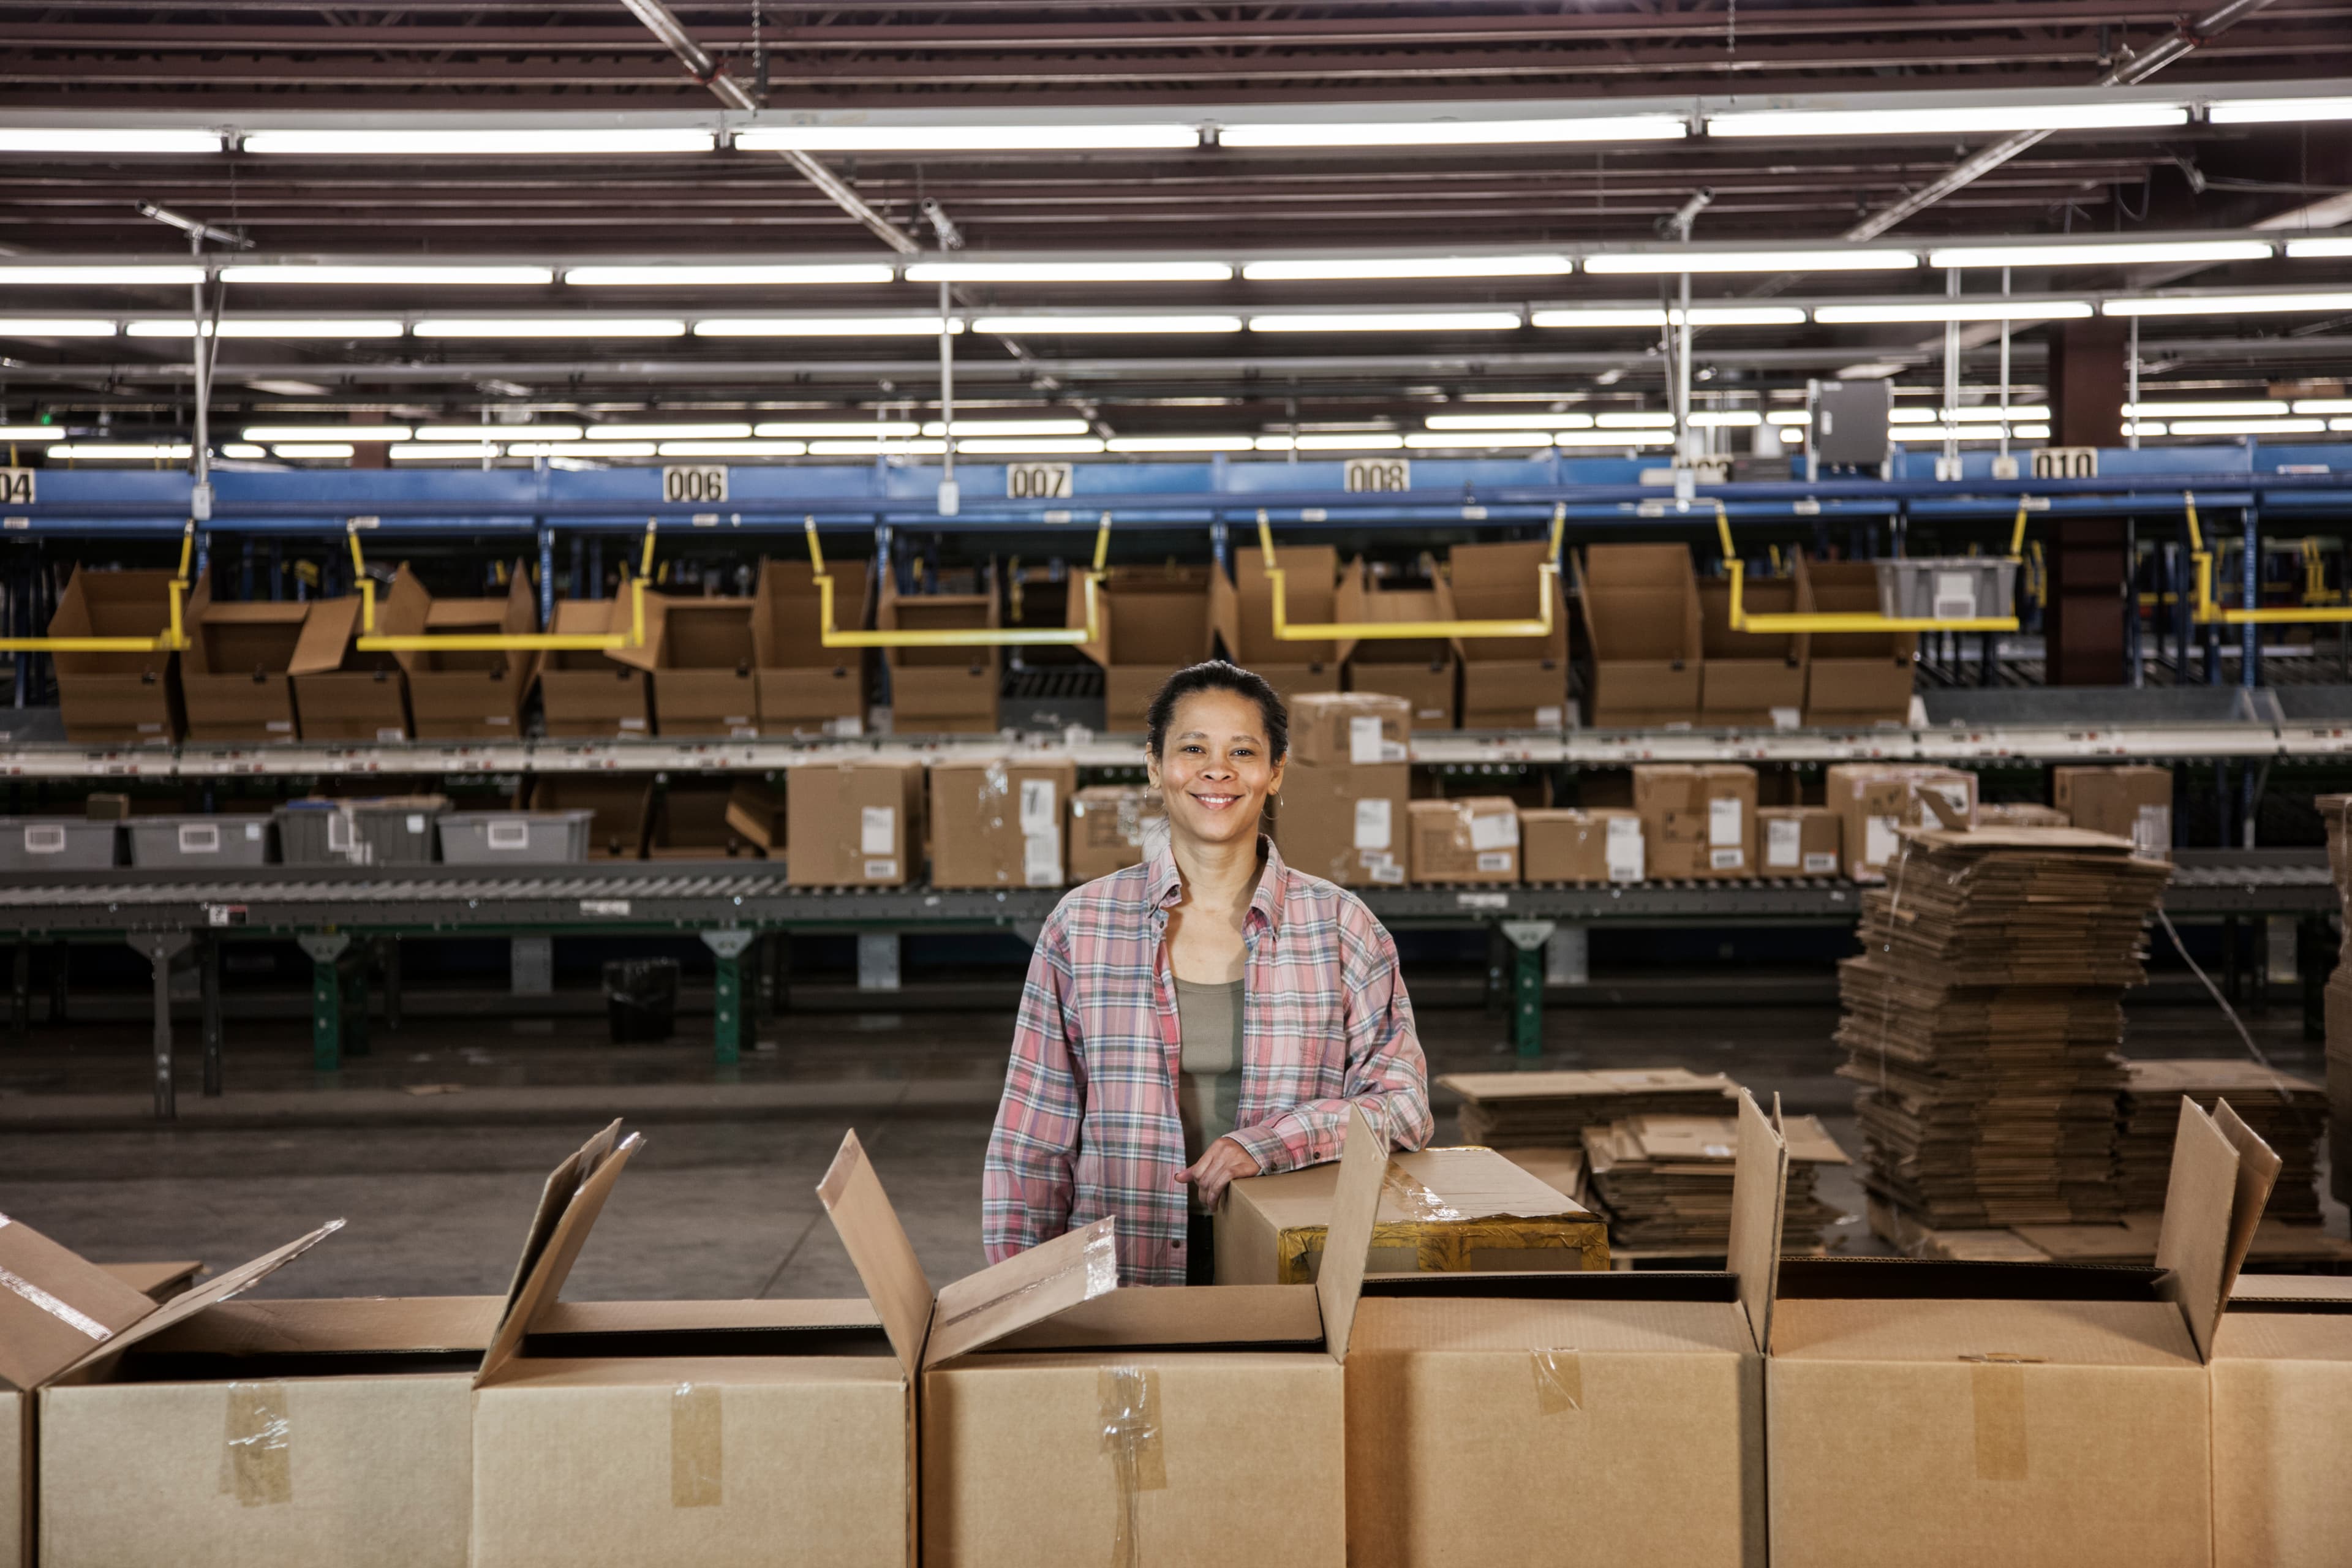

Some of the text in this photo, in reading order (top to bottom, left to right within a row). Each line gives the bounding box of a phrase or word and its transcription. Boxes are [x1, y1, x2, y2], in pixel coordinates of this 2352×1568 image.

[1351, 466, 1403, 492] 008
[2037, 454, 2090, 478] 010
[669, 471, 721, 500] 006
[1014, 469, 1065, 497] 007
